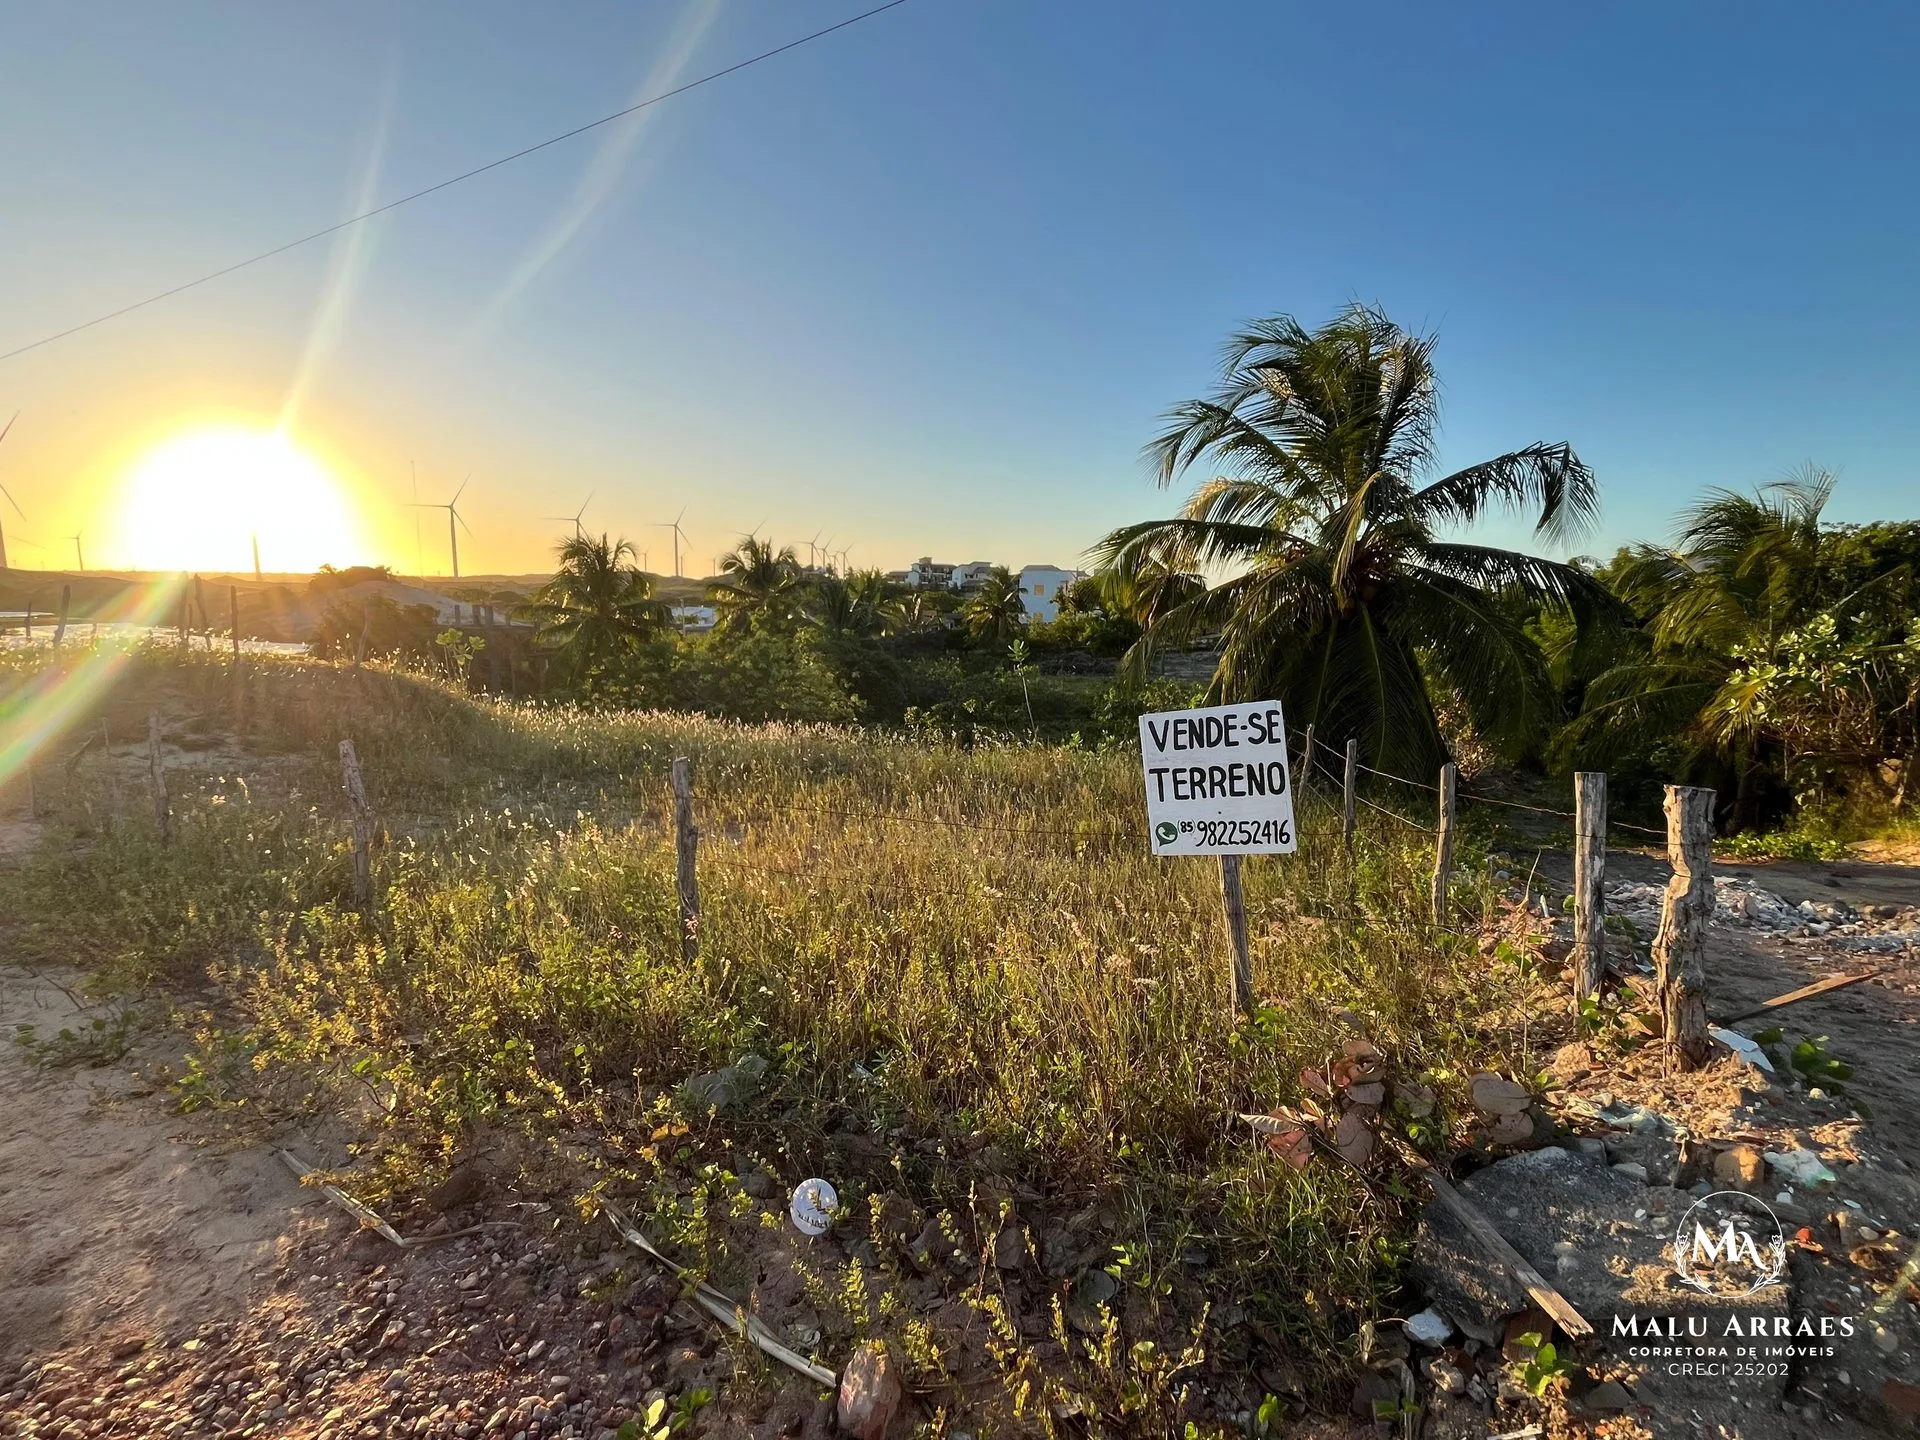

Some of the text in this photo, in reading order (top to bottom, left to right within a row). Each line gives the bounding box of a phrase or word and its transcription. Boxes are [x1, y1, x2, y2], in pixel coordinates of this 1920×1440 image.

[1148, 709, 1282, 753] VENDE-SE
[1148, 761, 1286, 802] TERRENO
[1195, 818, 1291, 848] 982252416
